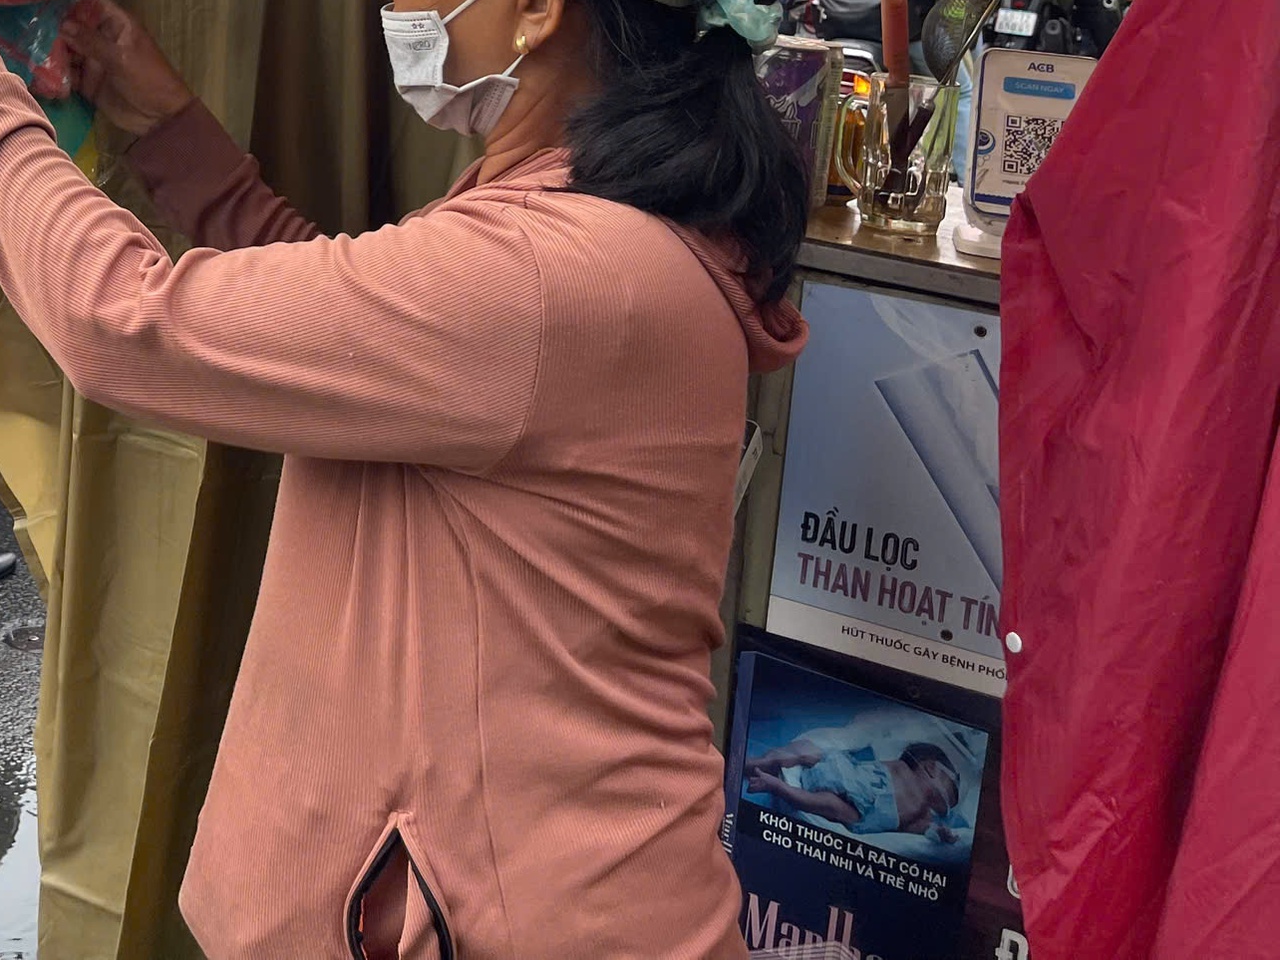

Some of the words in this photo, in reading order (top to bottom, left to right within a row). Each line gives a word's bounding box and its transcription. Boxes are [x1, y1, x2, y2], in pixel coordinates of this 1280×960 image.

[1027, 62, 1055, 74] ACB
[1040, 85, 1065, 94] NGAY
[800, 506, 858, 554] ĐẦU
[864, 527, 920, 572] LỌC
[797, 552, 872, 603] THAN
[877, 573, 954, 626] HOẠT
[841, 625, 867, 640] HÚT
[868, 632, 911, 653] THUỐC
[913, 646, 940, 661] GÂY
[941, 654, 976, 672] BỆNH
[977, 664, 1008, 681] PHỔ
[759, 810, 793, 833] KHÓI
[796, 823, 844, 850] THUỐC
[846, 841, 865, 859] LÁ
[868, 850, 897, 869] RẤT
[899, 861, 920, 878] CÓ
[922, 868, 947, 888] HẠI
[762, 829, 793, 849] CHO
[795, 840, 827, 861] THAI
[829, 854, 853, 872] NHI
[856, 862, 875, 880] VÀ
[877, 869, 906, 891] TRẺ
[908, 882, 939, 901] NHỎ
